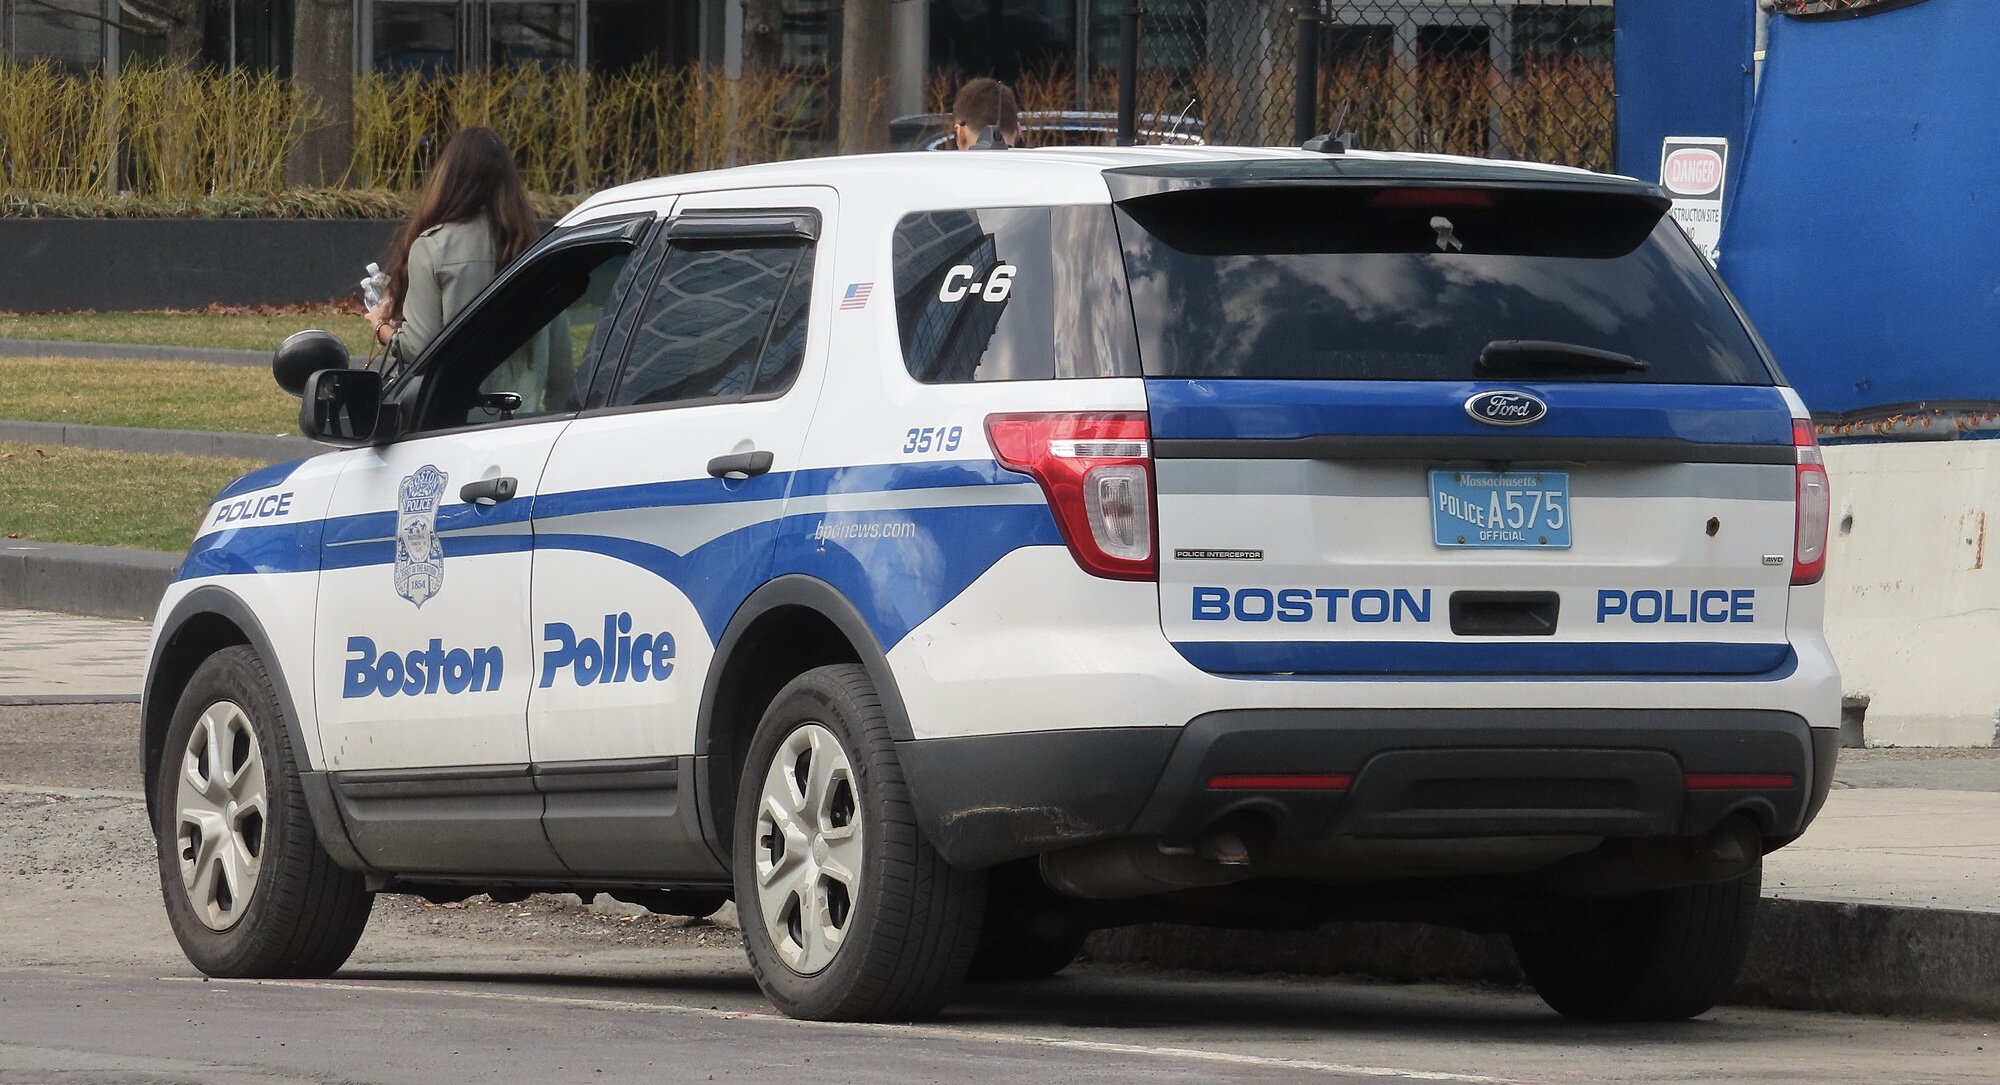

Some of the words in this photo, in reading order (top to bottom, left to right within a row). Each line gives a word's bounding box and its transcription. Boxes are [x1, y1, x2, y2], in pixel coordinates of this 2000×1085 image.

[1672, 160, 1715, 182] DANGER
[1671, 208, 1706, 222] STRUCTION
[1706, 209, 1719, 223] SITE
[939, 265, 1017, 302] C-6
[1486, 395, 1530, 416] Ford
[903, 426, 963, 453] 3519
[409, 470, 440, 493] BOSTON
[1460, 474, 1537, 487] Massachusetts
[212, 492, 294, 527] POLICE
[405, 499, 433, 512] POLICE
[1439, 491, 1485, 528] POLICE
[1488, 490, 1564, 529] A575
[815, 520, 916, 545] bpdnews.com
[1479, 531, 1526, 541] OFFICIAL
[411, 580, 426, 590] 1854
[1192, 587, 1431, 623] BOSTON
[1597, 590, 1755, 623] POLICE
[342, 636, 504, 698] Boston
[538, 612, 676, 688] Police
